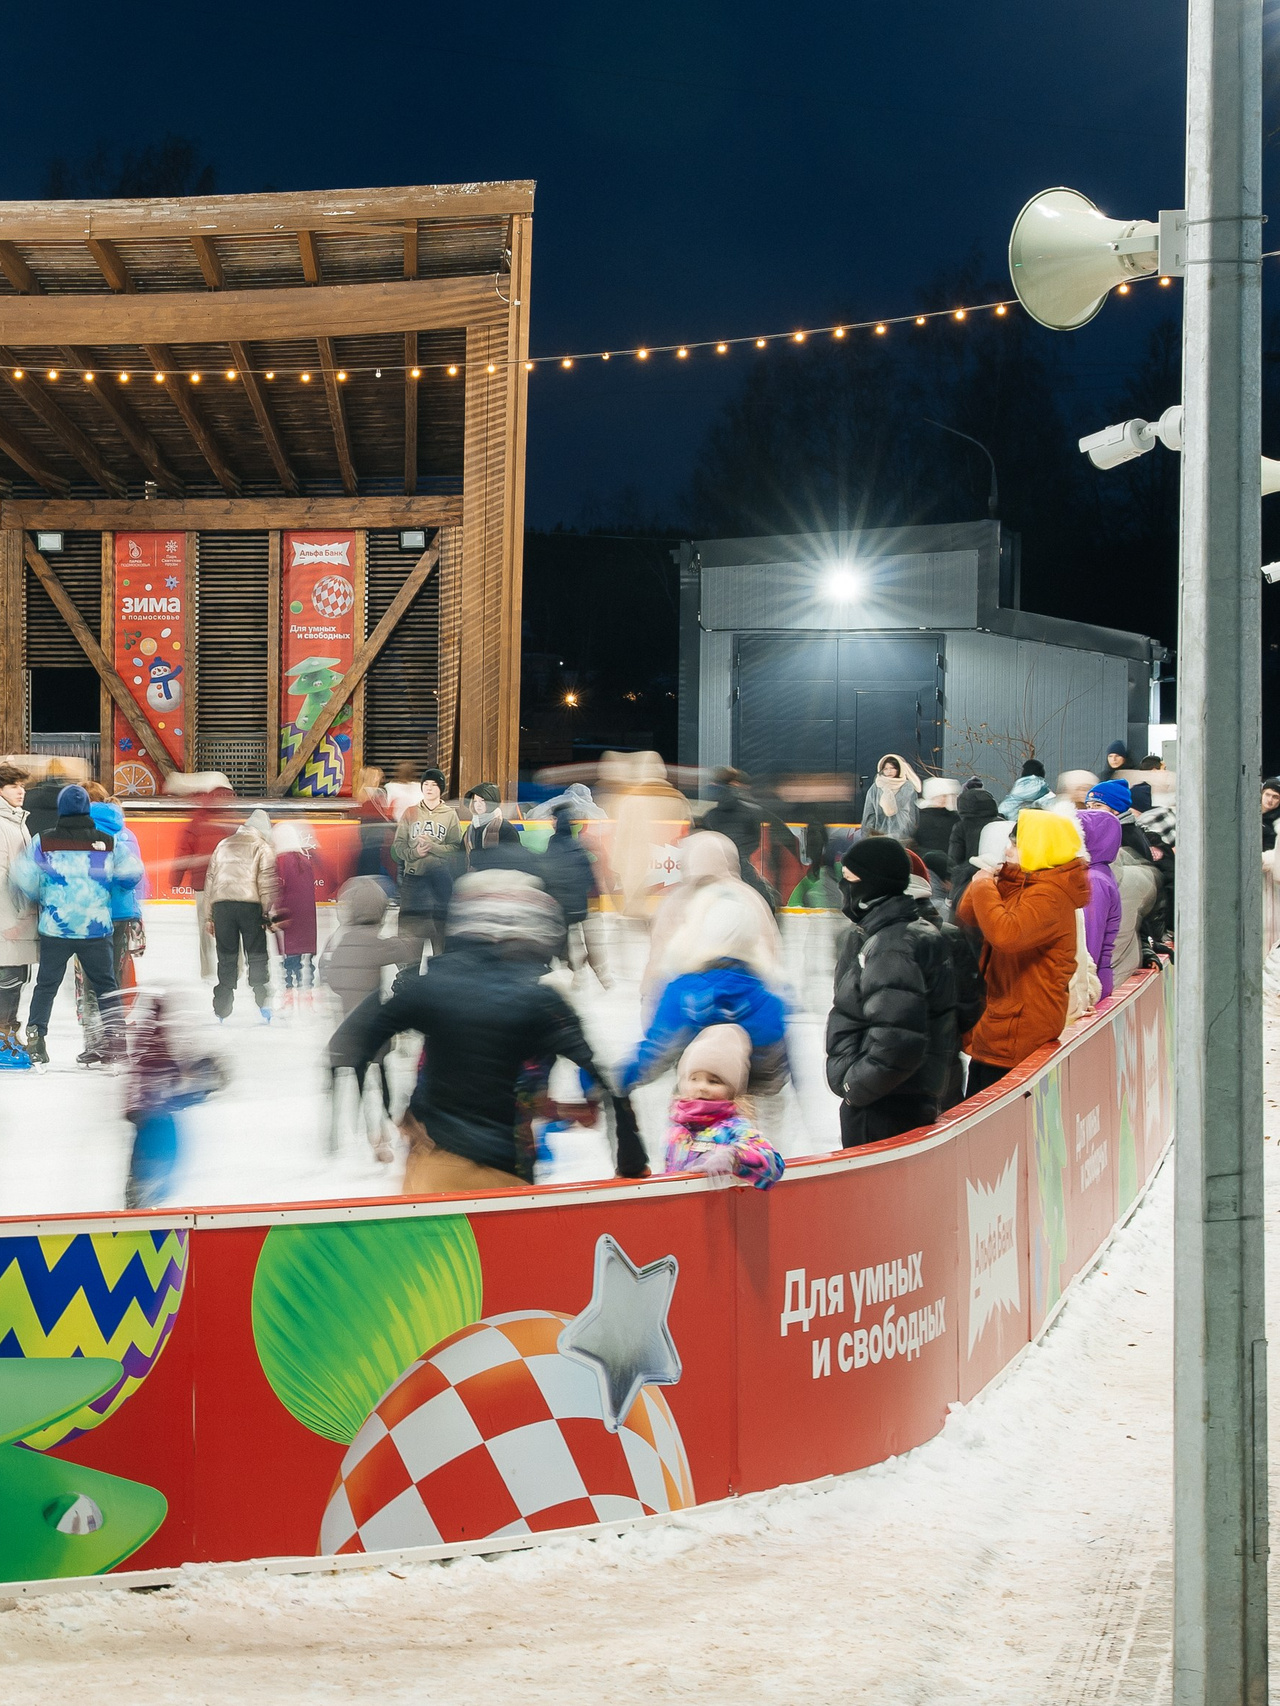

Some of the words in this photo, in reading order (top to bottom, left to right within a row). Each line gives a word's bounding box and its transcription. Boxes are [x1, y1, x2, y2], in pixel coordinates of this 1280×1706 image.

[300, 549, 323, 558] Альфа
[324, 549, 343, 557] Банк
[121, 596, 181, 613] зима
[290, 624, 307, 633] Для
[308, 624, 336, 633] умных
[297, 632, 303, 640] и
[304, 631, 351, 640] свободных
[780, 1267, 845, 1337] Для
[849, 1250, 924, 1324] умных
[812, 1337, 831, 1379] и
[837, 1296, 947, 1373] свободных
